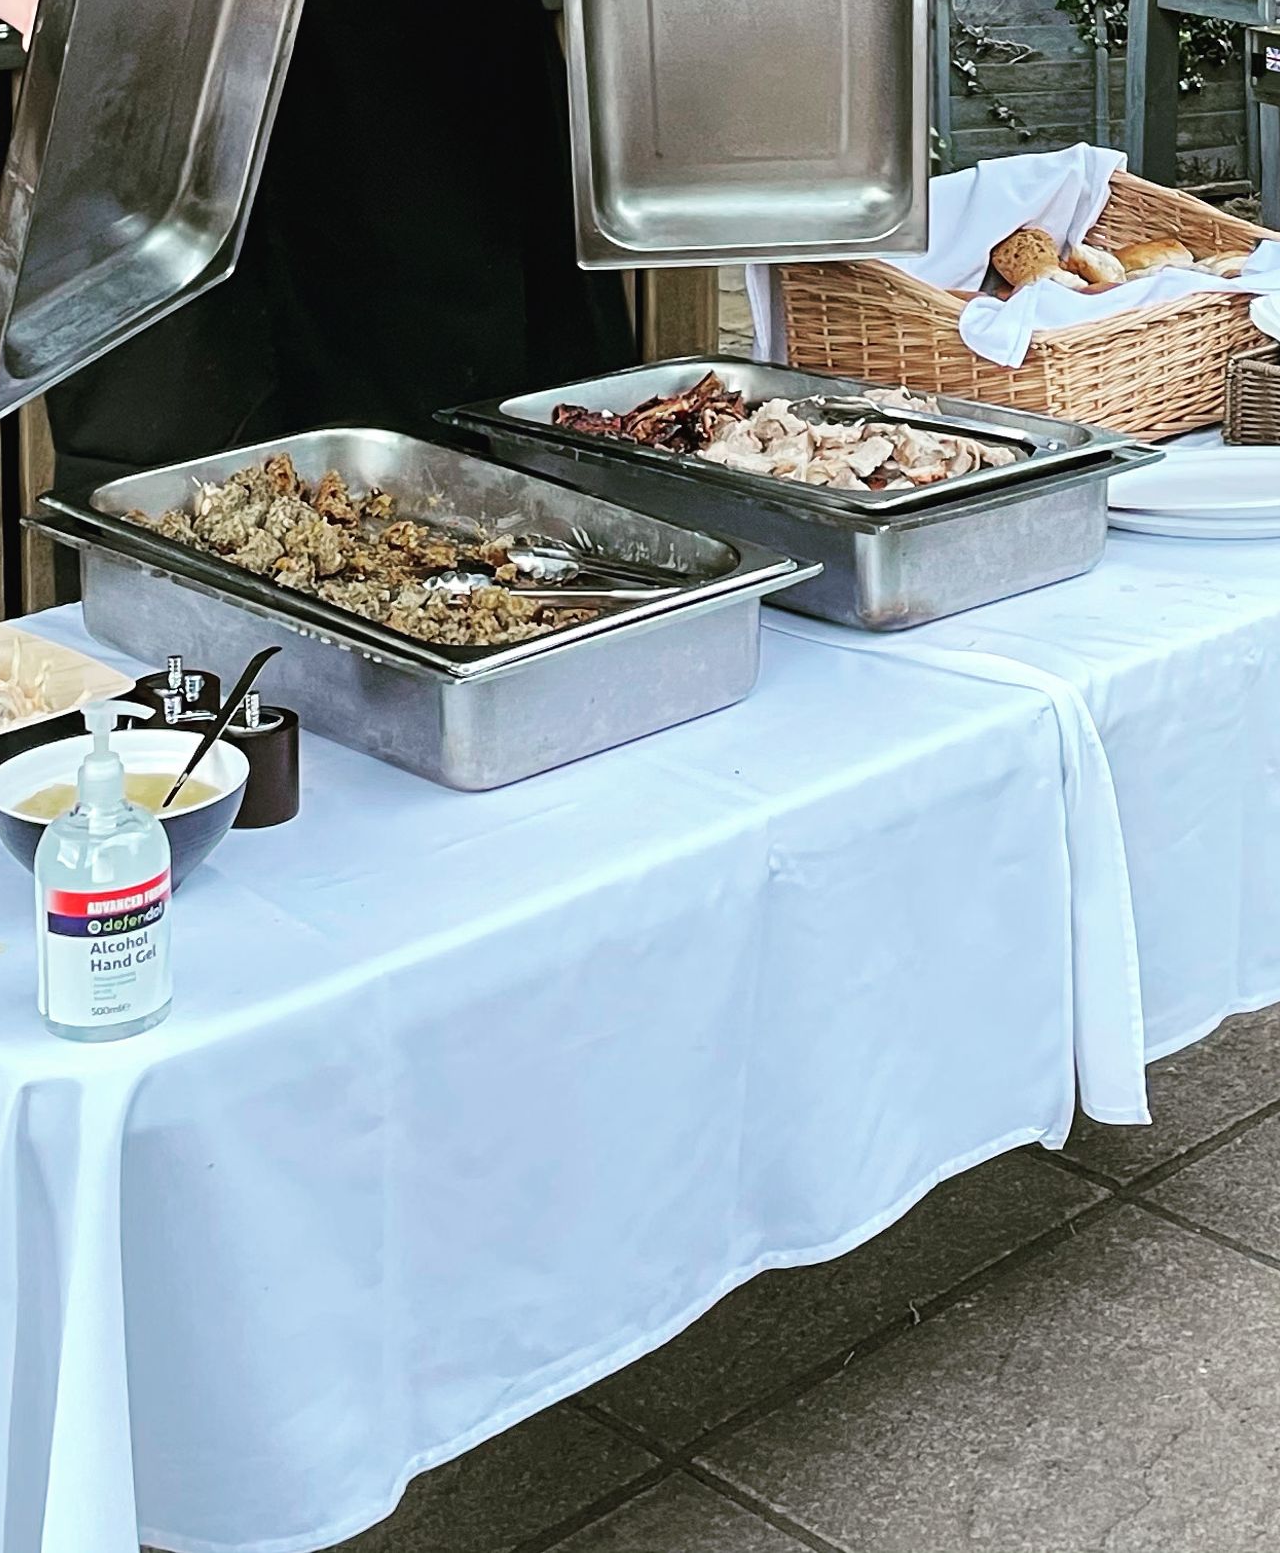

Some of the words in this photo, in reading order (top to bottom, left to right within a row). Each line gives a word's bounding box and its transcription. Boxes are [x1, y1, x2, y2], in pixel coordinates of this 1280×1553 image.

[87, 893, 144, 916] ADVANCED
[90, 931, 148, 955] Alcohol
[90, 953, 132, 972] Hand
[135, 944, 157, 963] Gel
